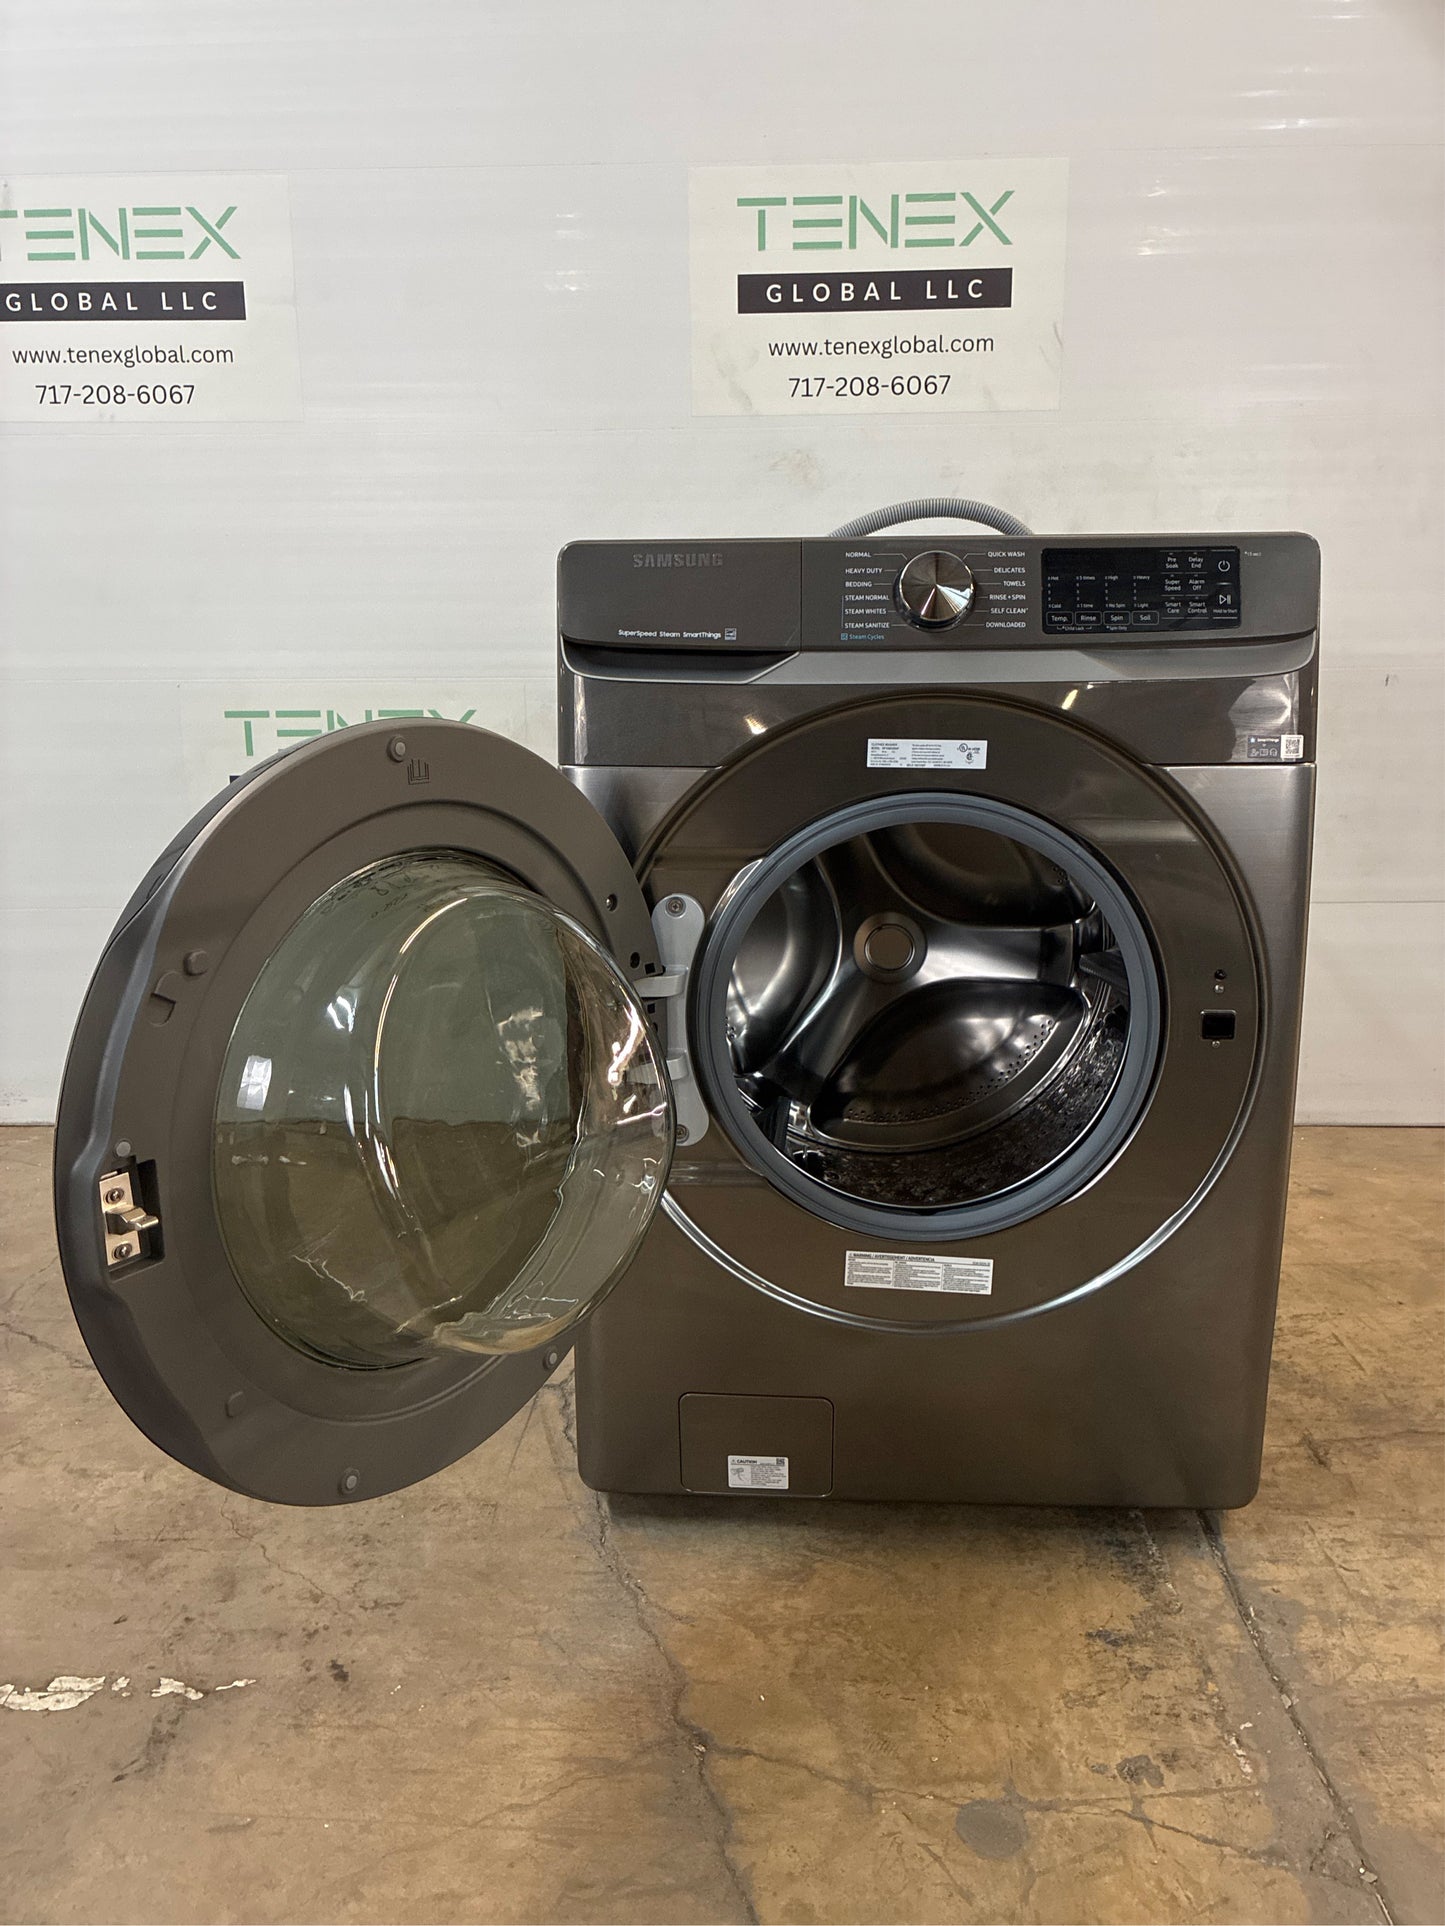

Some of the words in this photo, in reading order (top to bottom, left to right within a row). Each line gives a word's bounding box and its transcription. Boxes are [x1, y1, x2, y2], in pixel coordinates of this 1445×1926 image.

[737, 190, 1015, 251] TENEX
[5, 292, 138, 311] GLOBAL
[161, 292, 217, 310] LLC
[766, 281, 901, 303] GLOBAL
[926, 279, 983, 299] LLC
[12, 345, 234, 367] www.tenexglobal.com
[768, 334, 994, 359] www.tenexglobal.com
[35, 385, 195, 405] 717-208-6067
[788, 375, 951, 397] 717-208-6067
[632, 553, 723, 568] SAMSUNG
[618, 629, 657, 638] SuperSpeed
[682, 632, 721, 640] SmartThings
